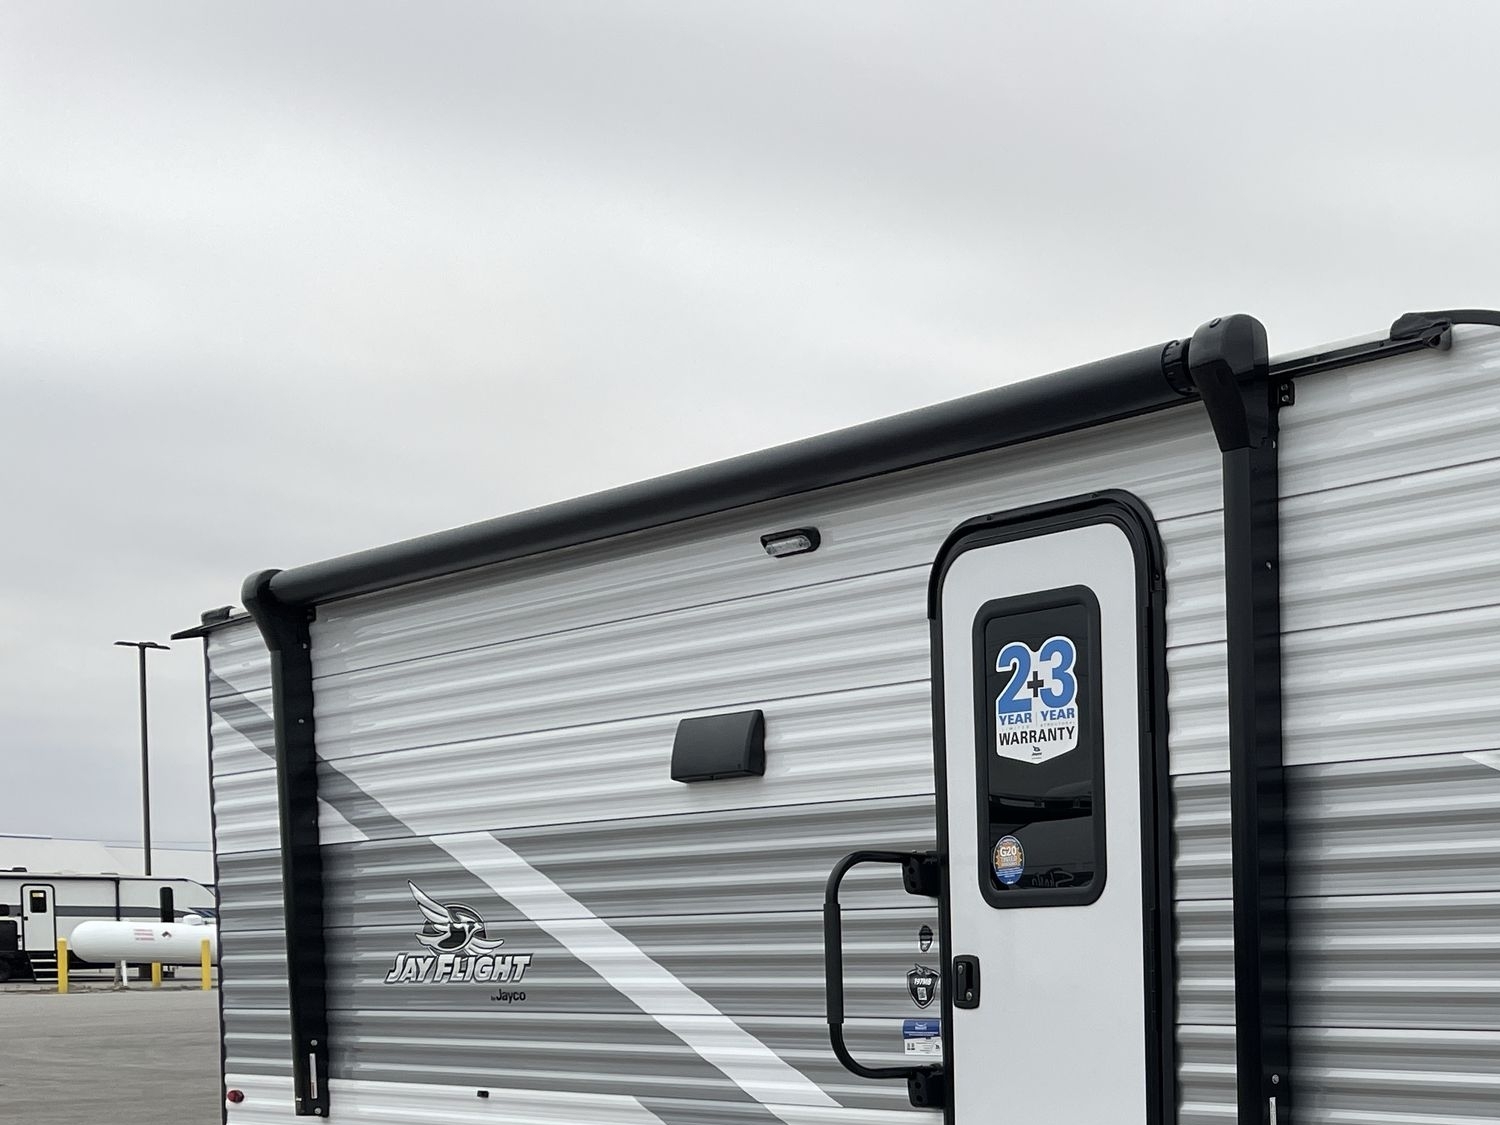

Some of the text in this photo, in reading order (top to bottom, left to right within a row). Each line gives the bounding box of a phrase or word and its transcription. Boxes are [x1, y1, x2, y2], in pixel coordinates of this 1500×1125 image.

[999, 712, 1032, 726] YEAR
[1040, 707, 1075, 721] YEAR
[999, 726, 1075, 746] WARRANTY
[1000, 846, 1017, 857] G20
[385, 952, 534, 985] JAY FLIGHT
[496, 989, 526, 1004] Jayco
